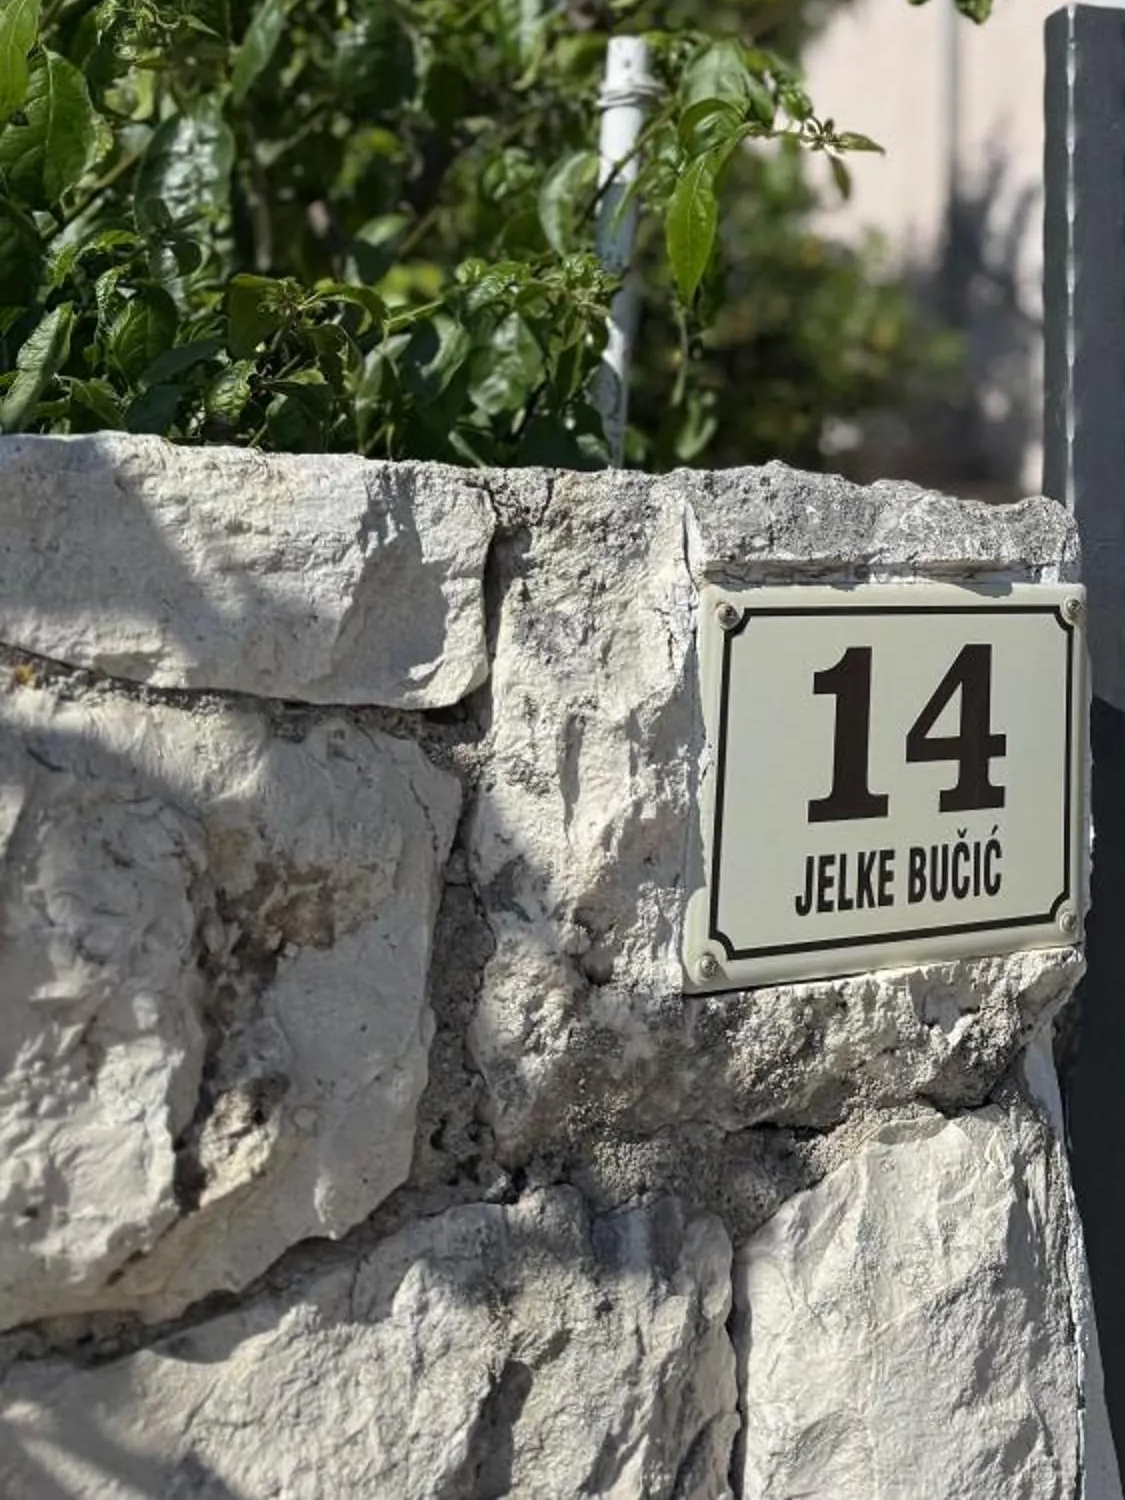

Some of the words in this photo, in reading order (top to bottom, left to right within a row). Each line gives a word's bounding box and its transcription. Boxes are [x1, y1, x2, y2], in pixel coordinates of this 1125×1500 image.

[808, 643, 1007, 823] 14
[795, 849, 895, 917] JELKE
[907, 825, 1003, 904] BUČIĆ
